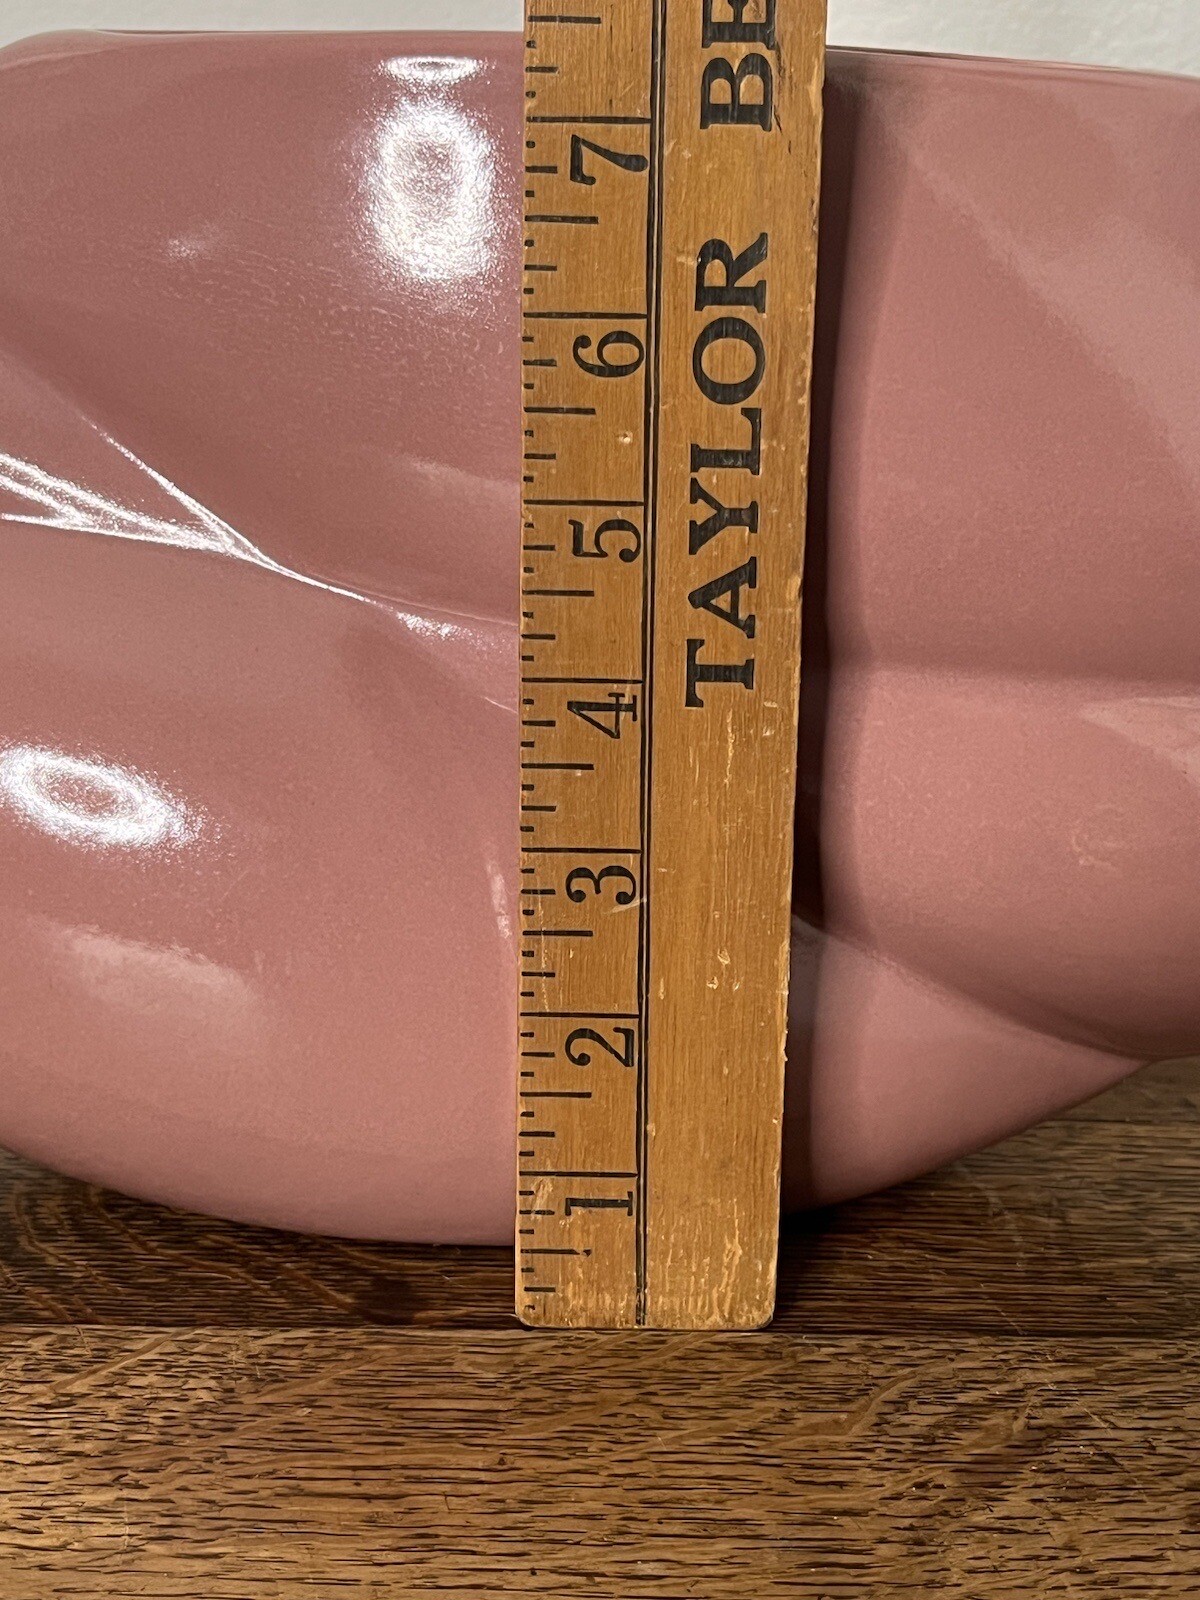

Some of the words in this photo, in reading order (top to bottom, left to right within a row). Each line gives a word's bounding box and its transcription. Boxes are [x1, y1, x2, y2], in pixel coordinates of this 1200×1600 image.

[700, 0, 777, 132] BE
[569, 133, 649, 186] 7
[572, 330, 645, 378] 6
[685, 232, 769, 708] TAYLOR
[568, 518, 642, 563] 5
[566, 692, 638, 739] 4
[565, 865, 637, 905] 3
[564, 1026, 635, 1068] 2
[564, 1190, 634, 1217] 1
